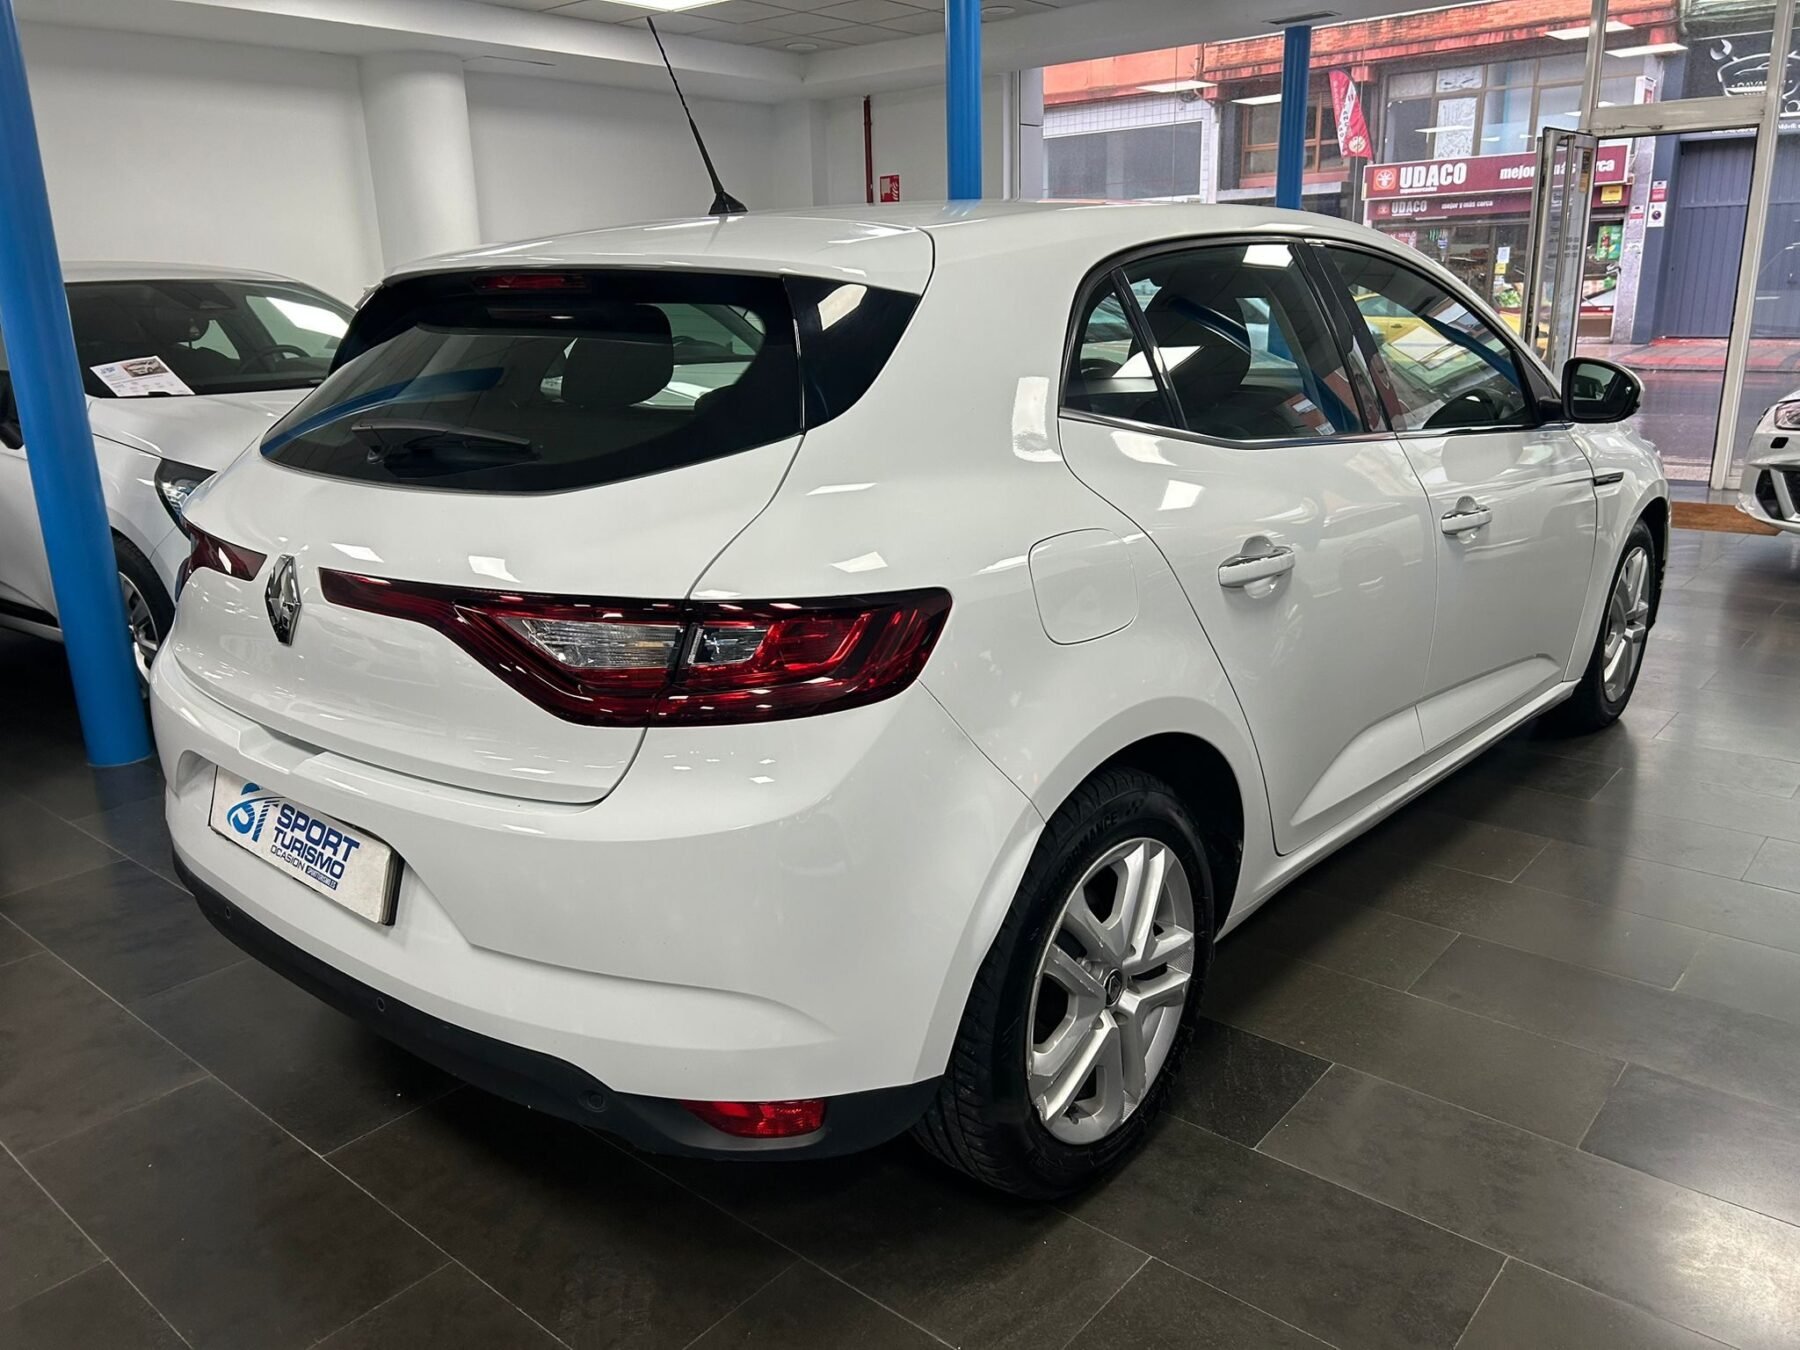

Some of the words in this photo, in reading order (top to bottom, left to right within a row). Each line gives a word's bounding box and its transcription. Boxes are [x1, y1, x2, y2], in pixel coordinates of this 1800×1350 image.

[1400, 162, 1467, 188] UDACO
[1499, 165, 1536, 180] mejor
[1391, 201, 1427, 213] UDACO
[277, 803, 360, 862] SPORT
[270, 844, 305, 871] OCASION
[273, 826, 345, 880] TURISMO
